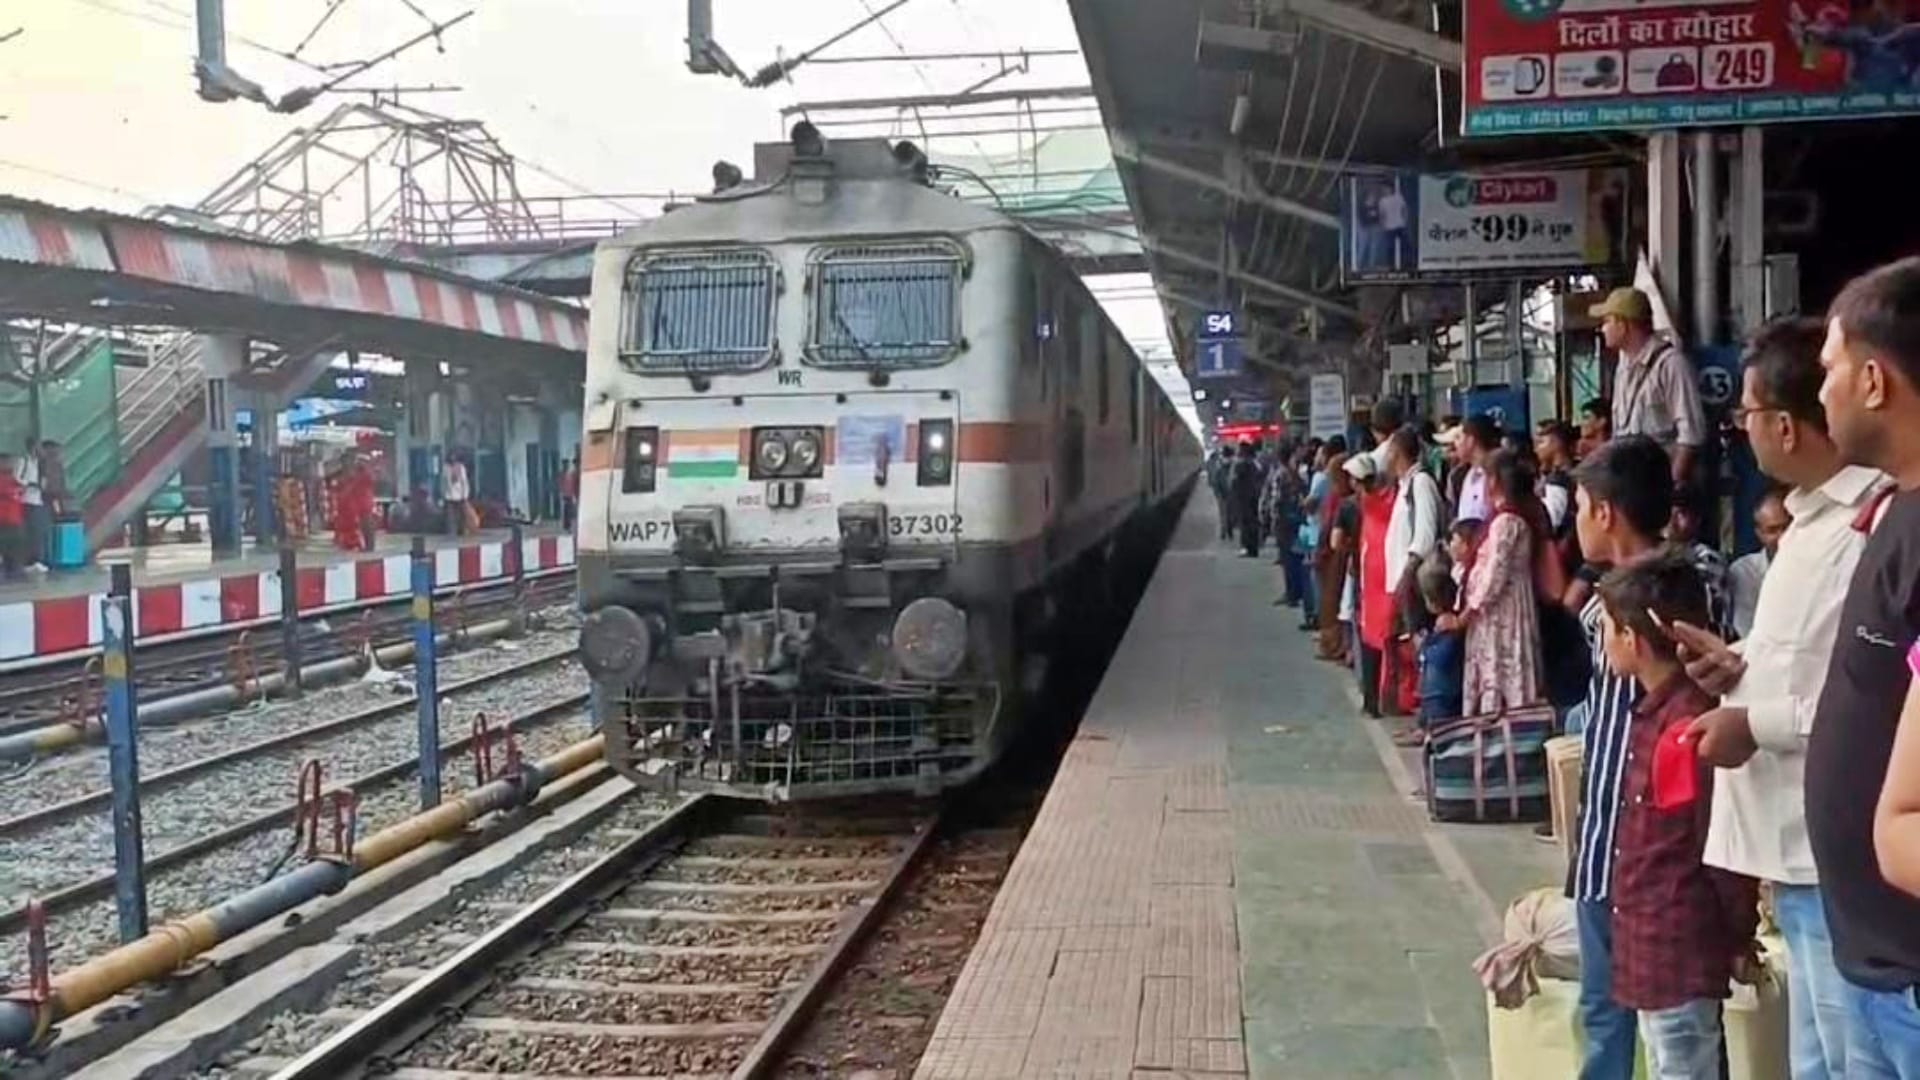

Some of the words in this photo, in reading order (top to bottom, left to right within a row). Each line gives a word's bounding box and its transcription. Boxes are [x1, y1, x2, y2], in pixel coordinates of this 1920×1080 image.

[1560, 15, 1620, 45] दिलों
[1629, 18, 1664, 42] का
[1208, 315, 1231, 332] S4
[1208, 343, 1223, 369] 1
[777, 370, 802, 387] WR
[610, 521, 669, 542] WAP7
[890, 514, 963, 535] 37302
